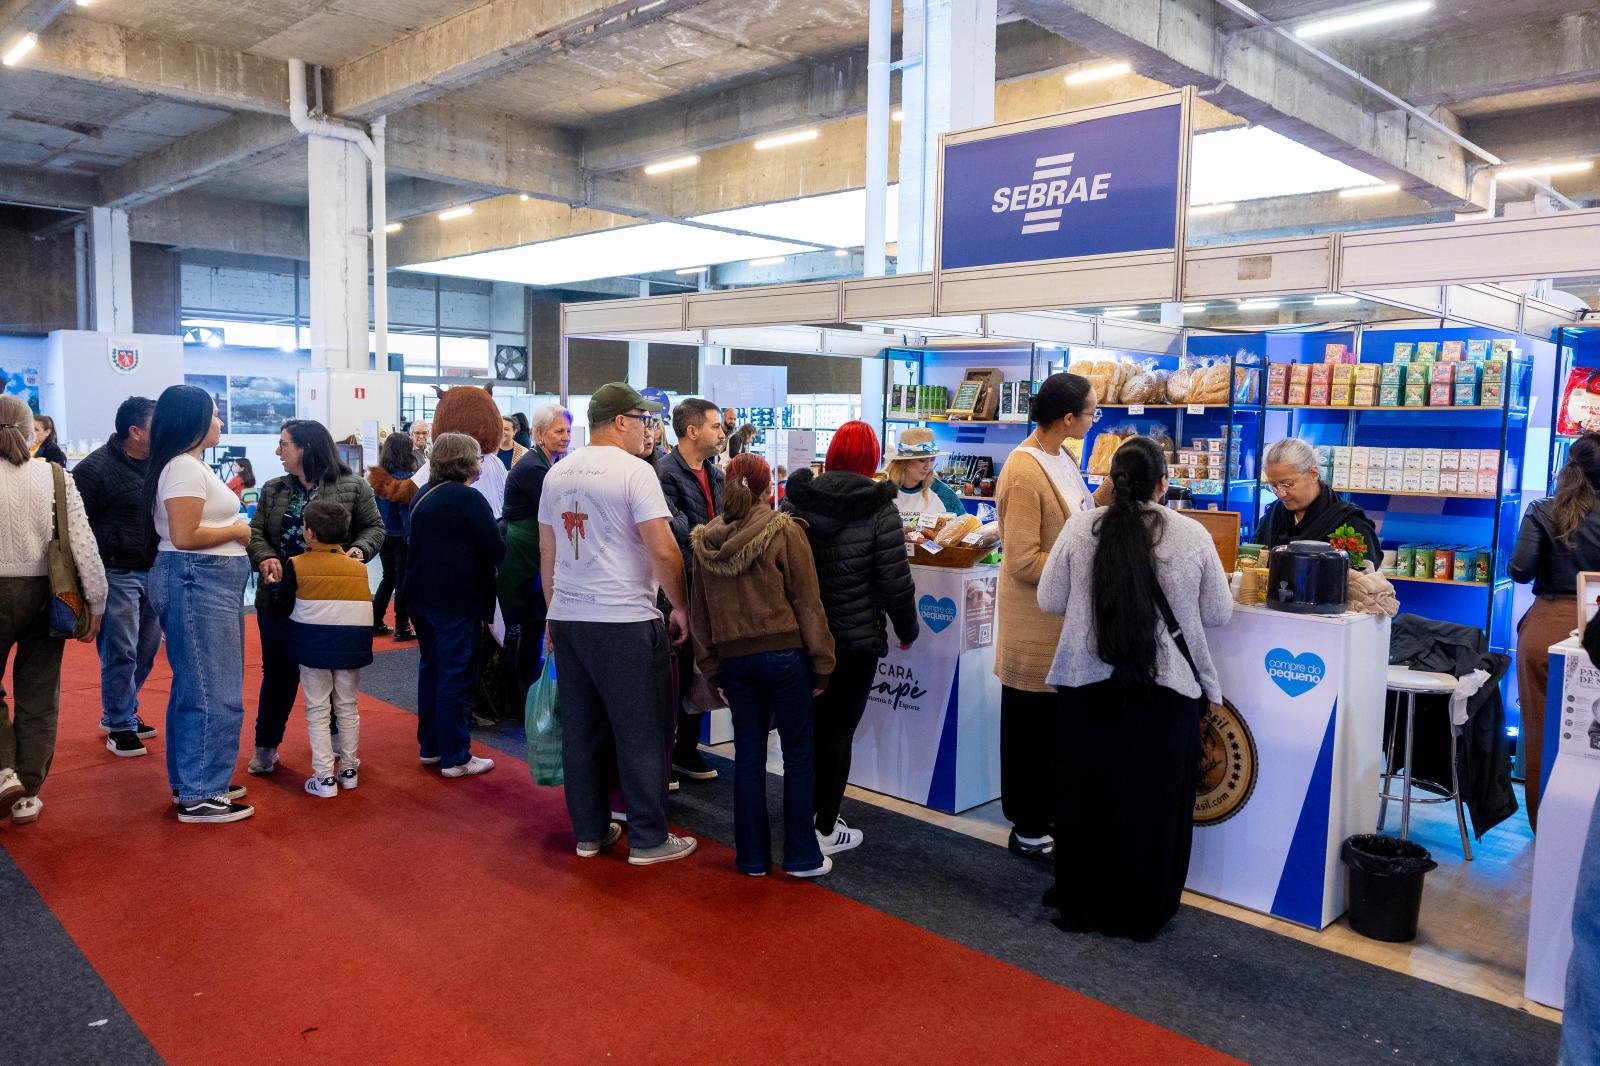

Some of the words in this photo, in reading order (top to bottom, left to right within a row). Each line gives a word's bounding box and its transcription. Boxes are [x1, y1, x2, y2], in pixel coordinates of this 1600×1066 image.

[991, 173, 1112, 213] SEBRAE
[921, 604, 945, 615] compre
[921, 610, 954, 622] pequeno
[878, 662, 914, 681] CARA
[1269, 658, 1306, 674] compre
[1307, 664, 1321, 675] do
[1580, 668, 1600, 677] PAS
[1269, 668, 1321, 683] pequeno
[1195, 791, 1230, 811] asil.com
